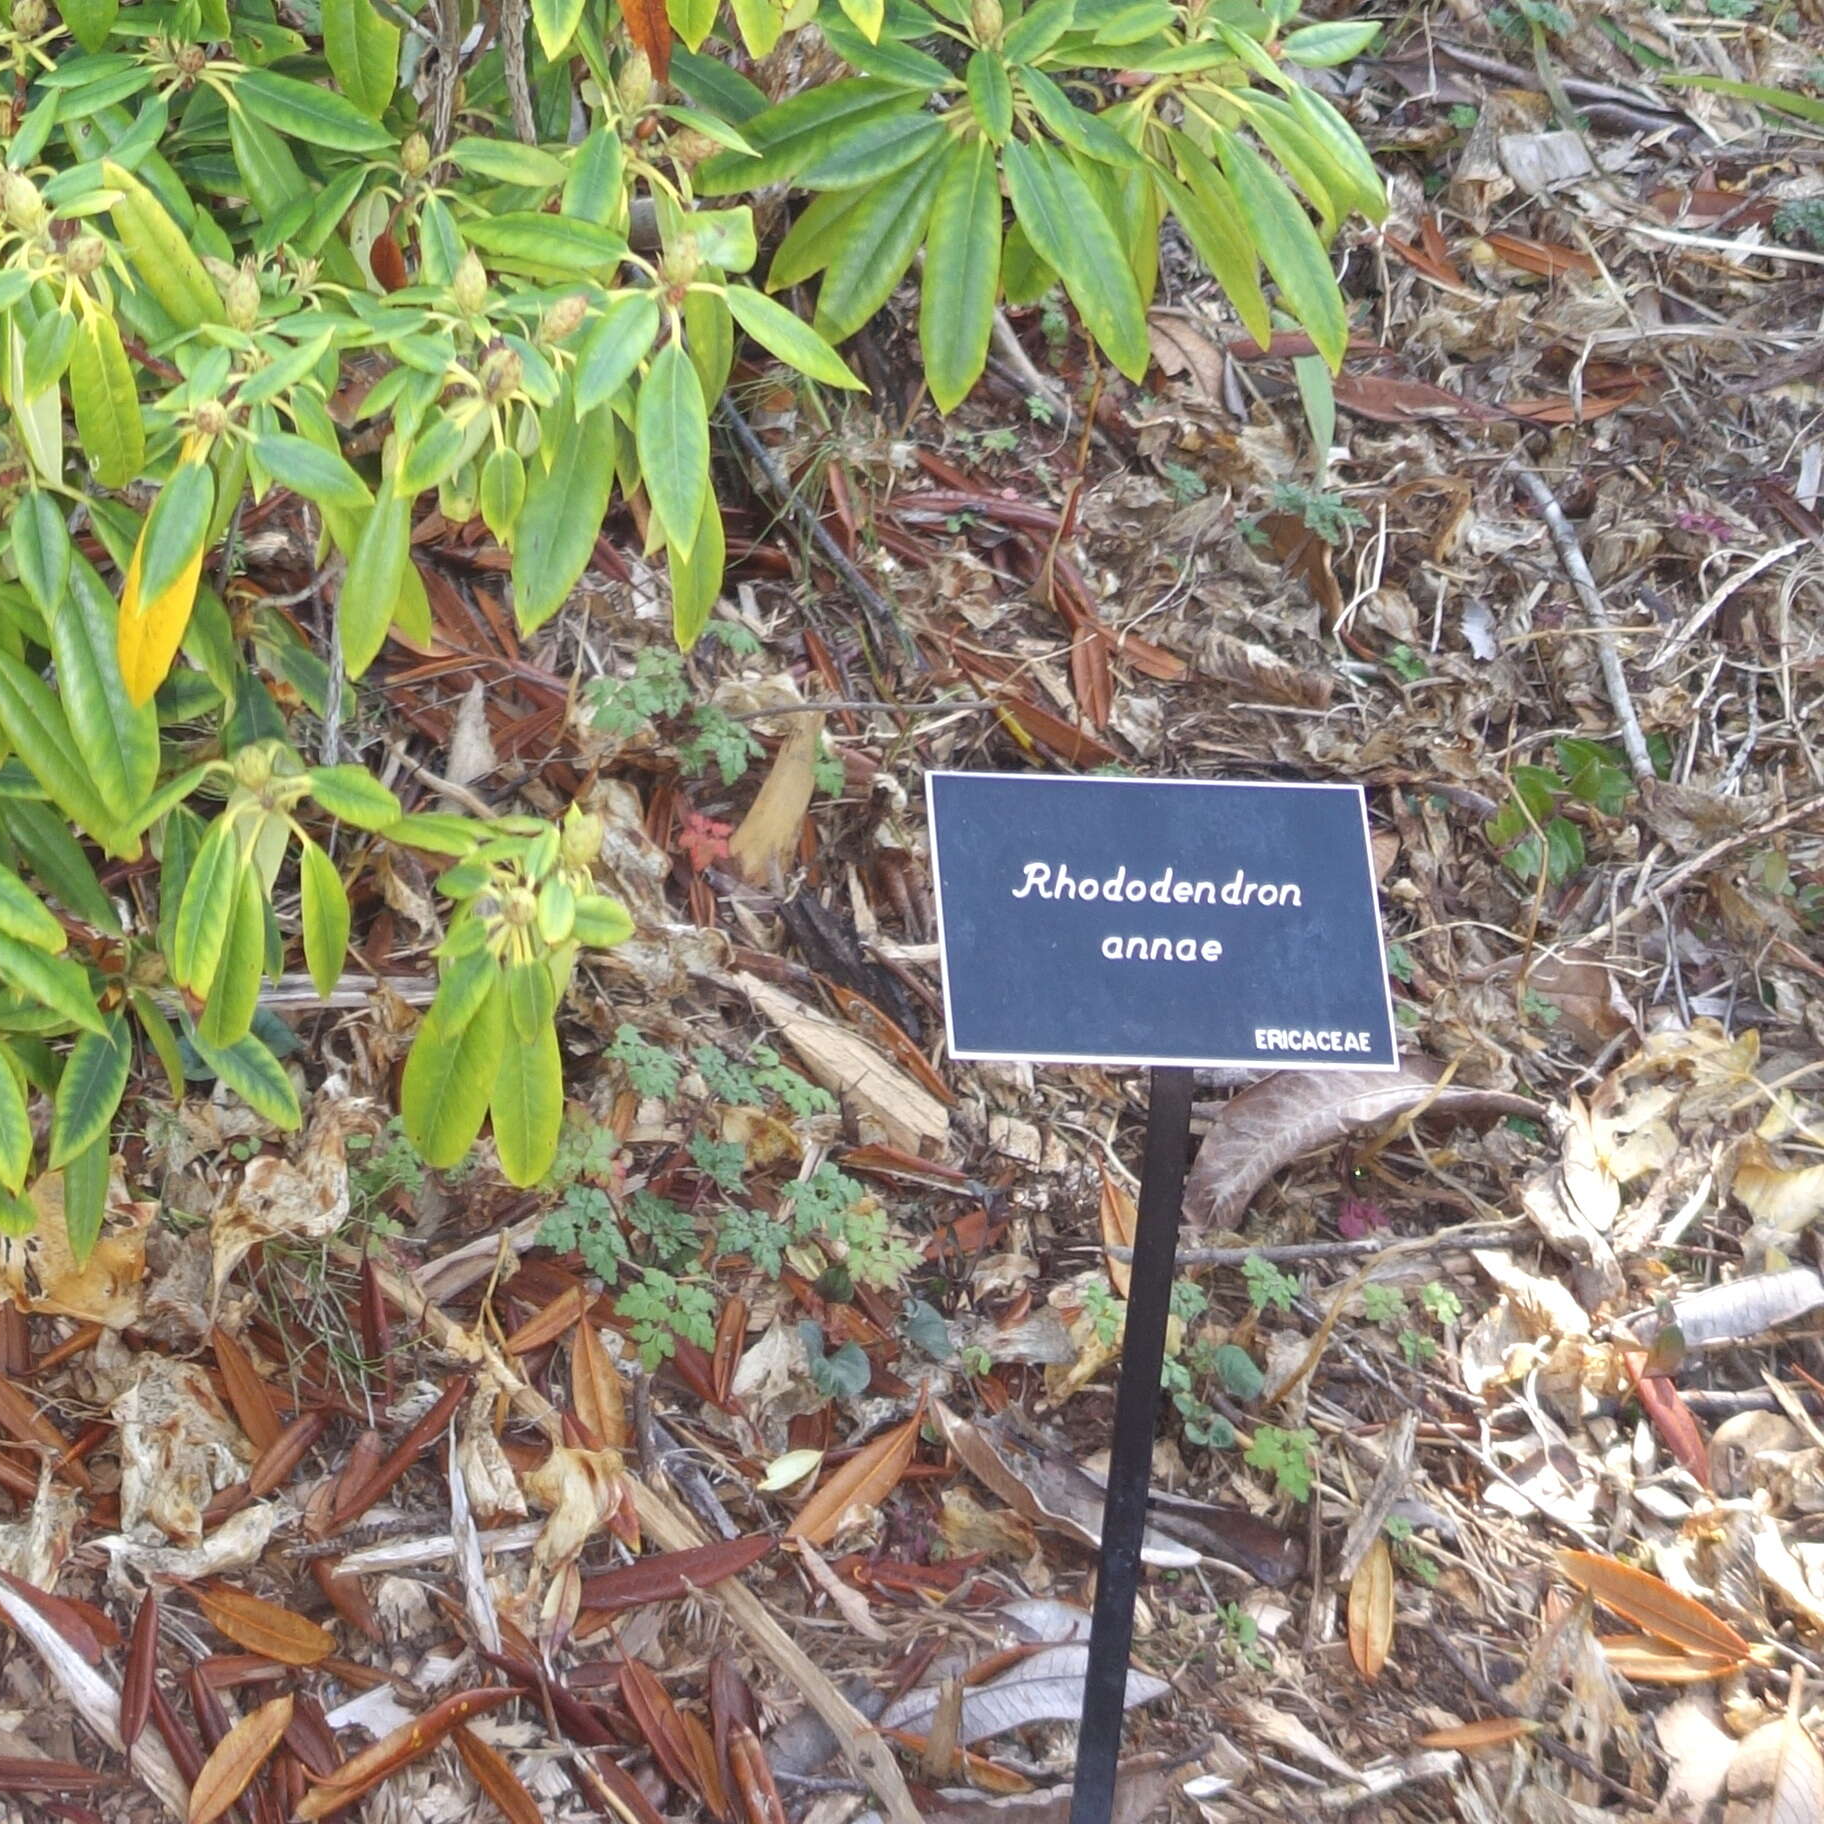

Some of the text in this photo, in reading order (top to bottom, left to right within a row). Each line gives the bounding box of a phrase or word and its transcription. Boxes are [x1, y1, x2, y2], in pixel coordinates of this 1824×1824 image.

[1012, 862, 1302, 907] Rhododendron
[1101, 933, 1223, 962] annae
[1255, 1029, 1372, 1053] ERICACEAE
